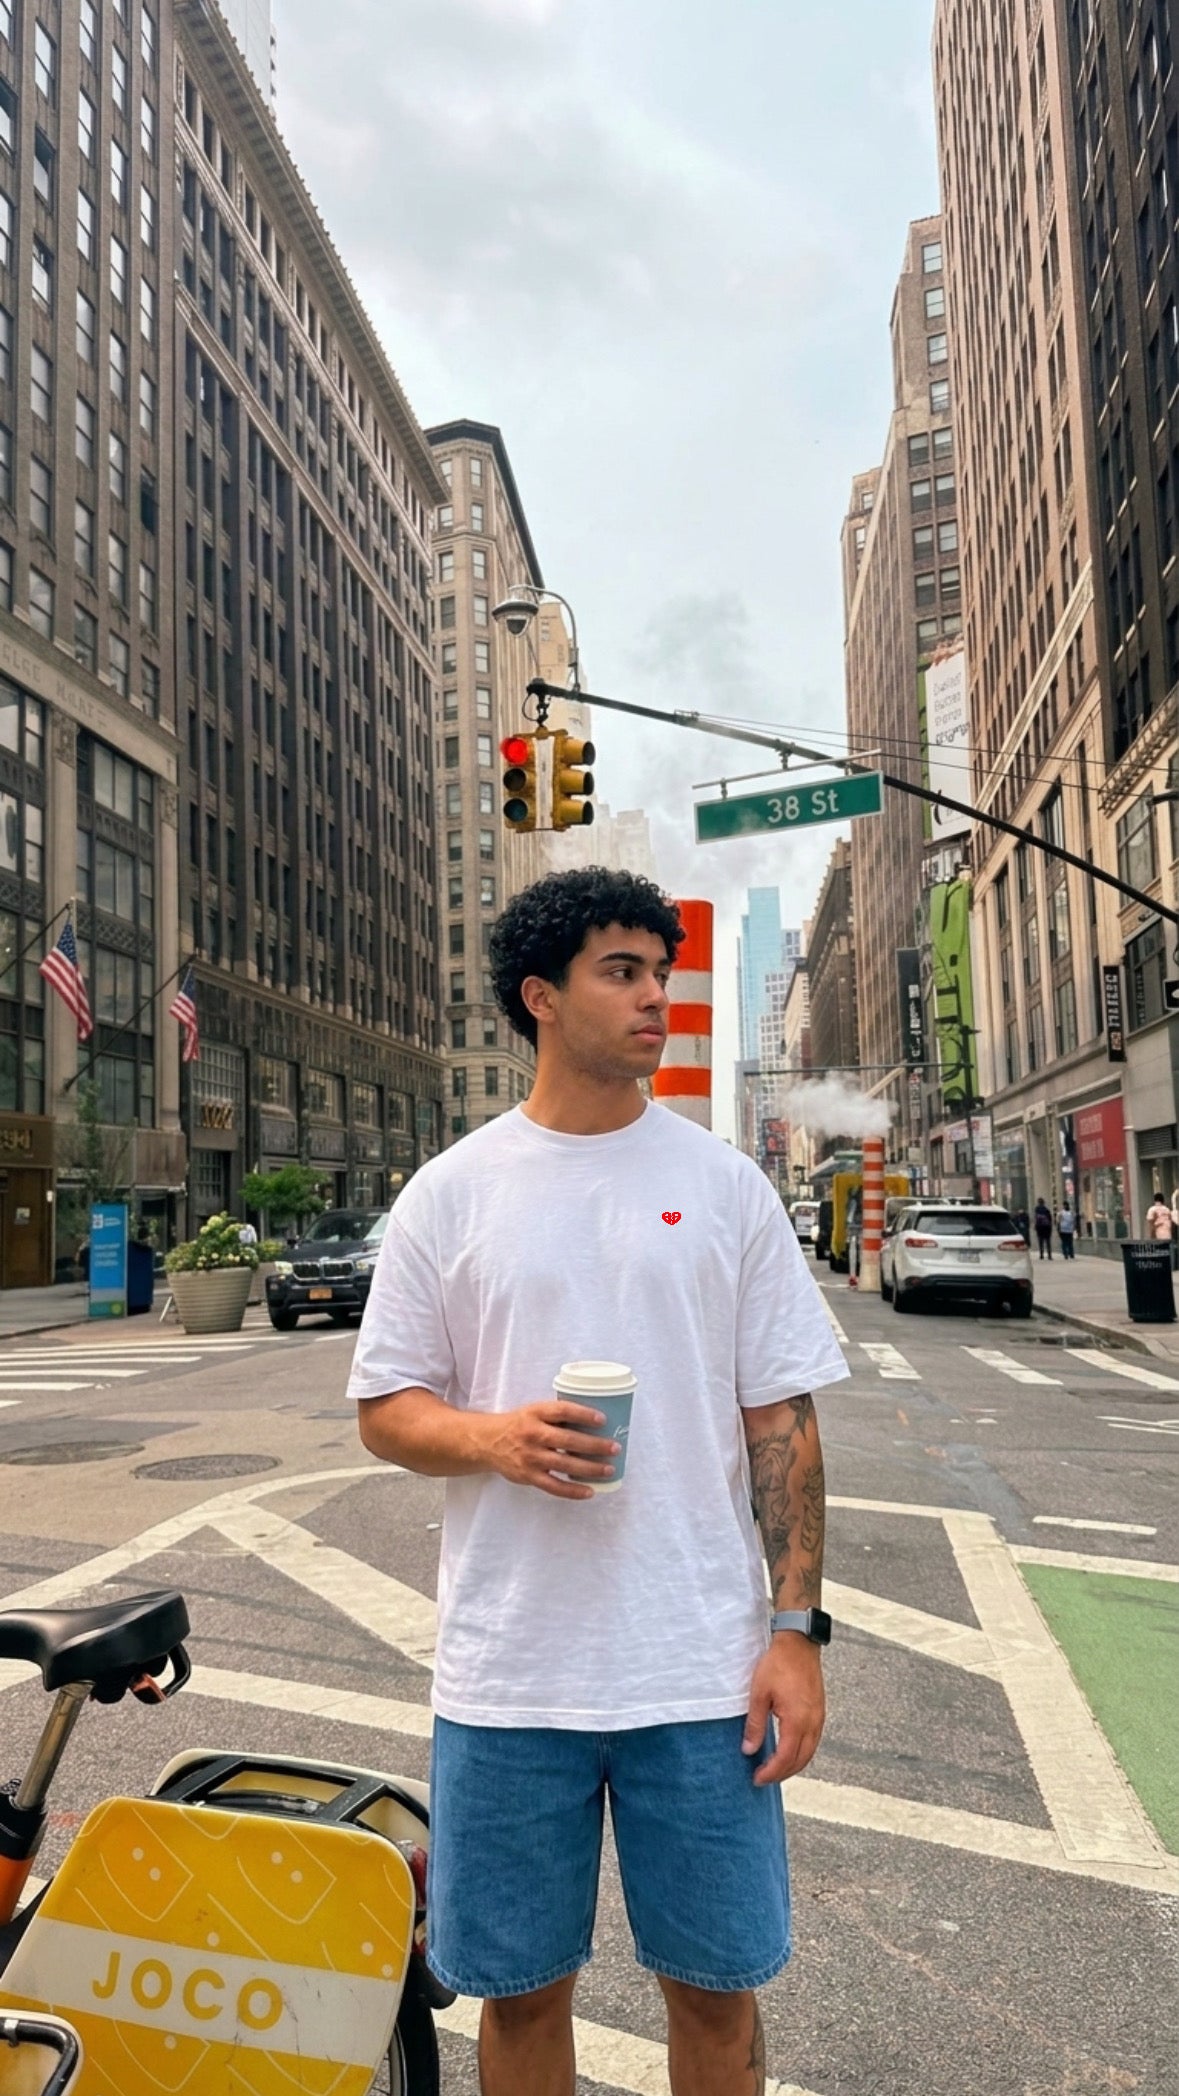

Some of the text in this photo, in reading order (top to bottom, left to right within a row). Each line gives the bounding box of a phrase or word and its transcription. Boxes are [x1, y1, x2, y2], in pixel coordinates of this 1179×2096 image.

[767, 789, 839, 823] 38 St
[92, 1951, 284, 2031] JOCO
